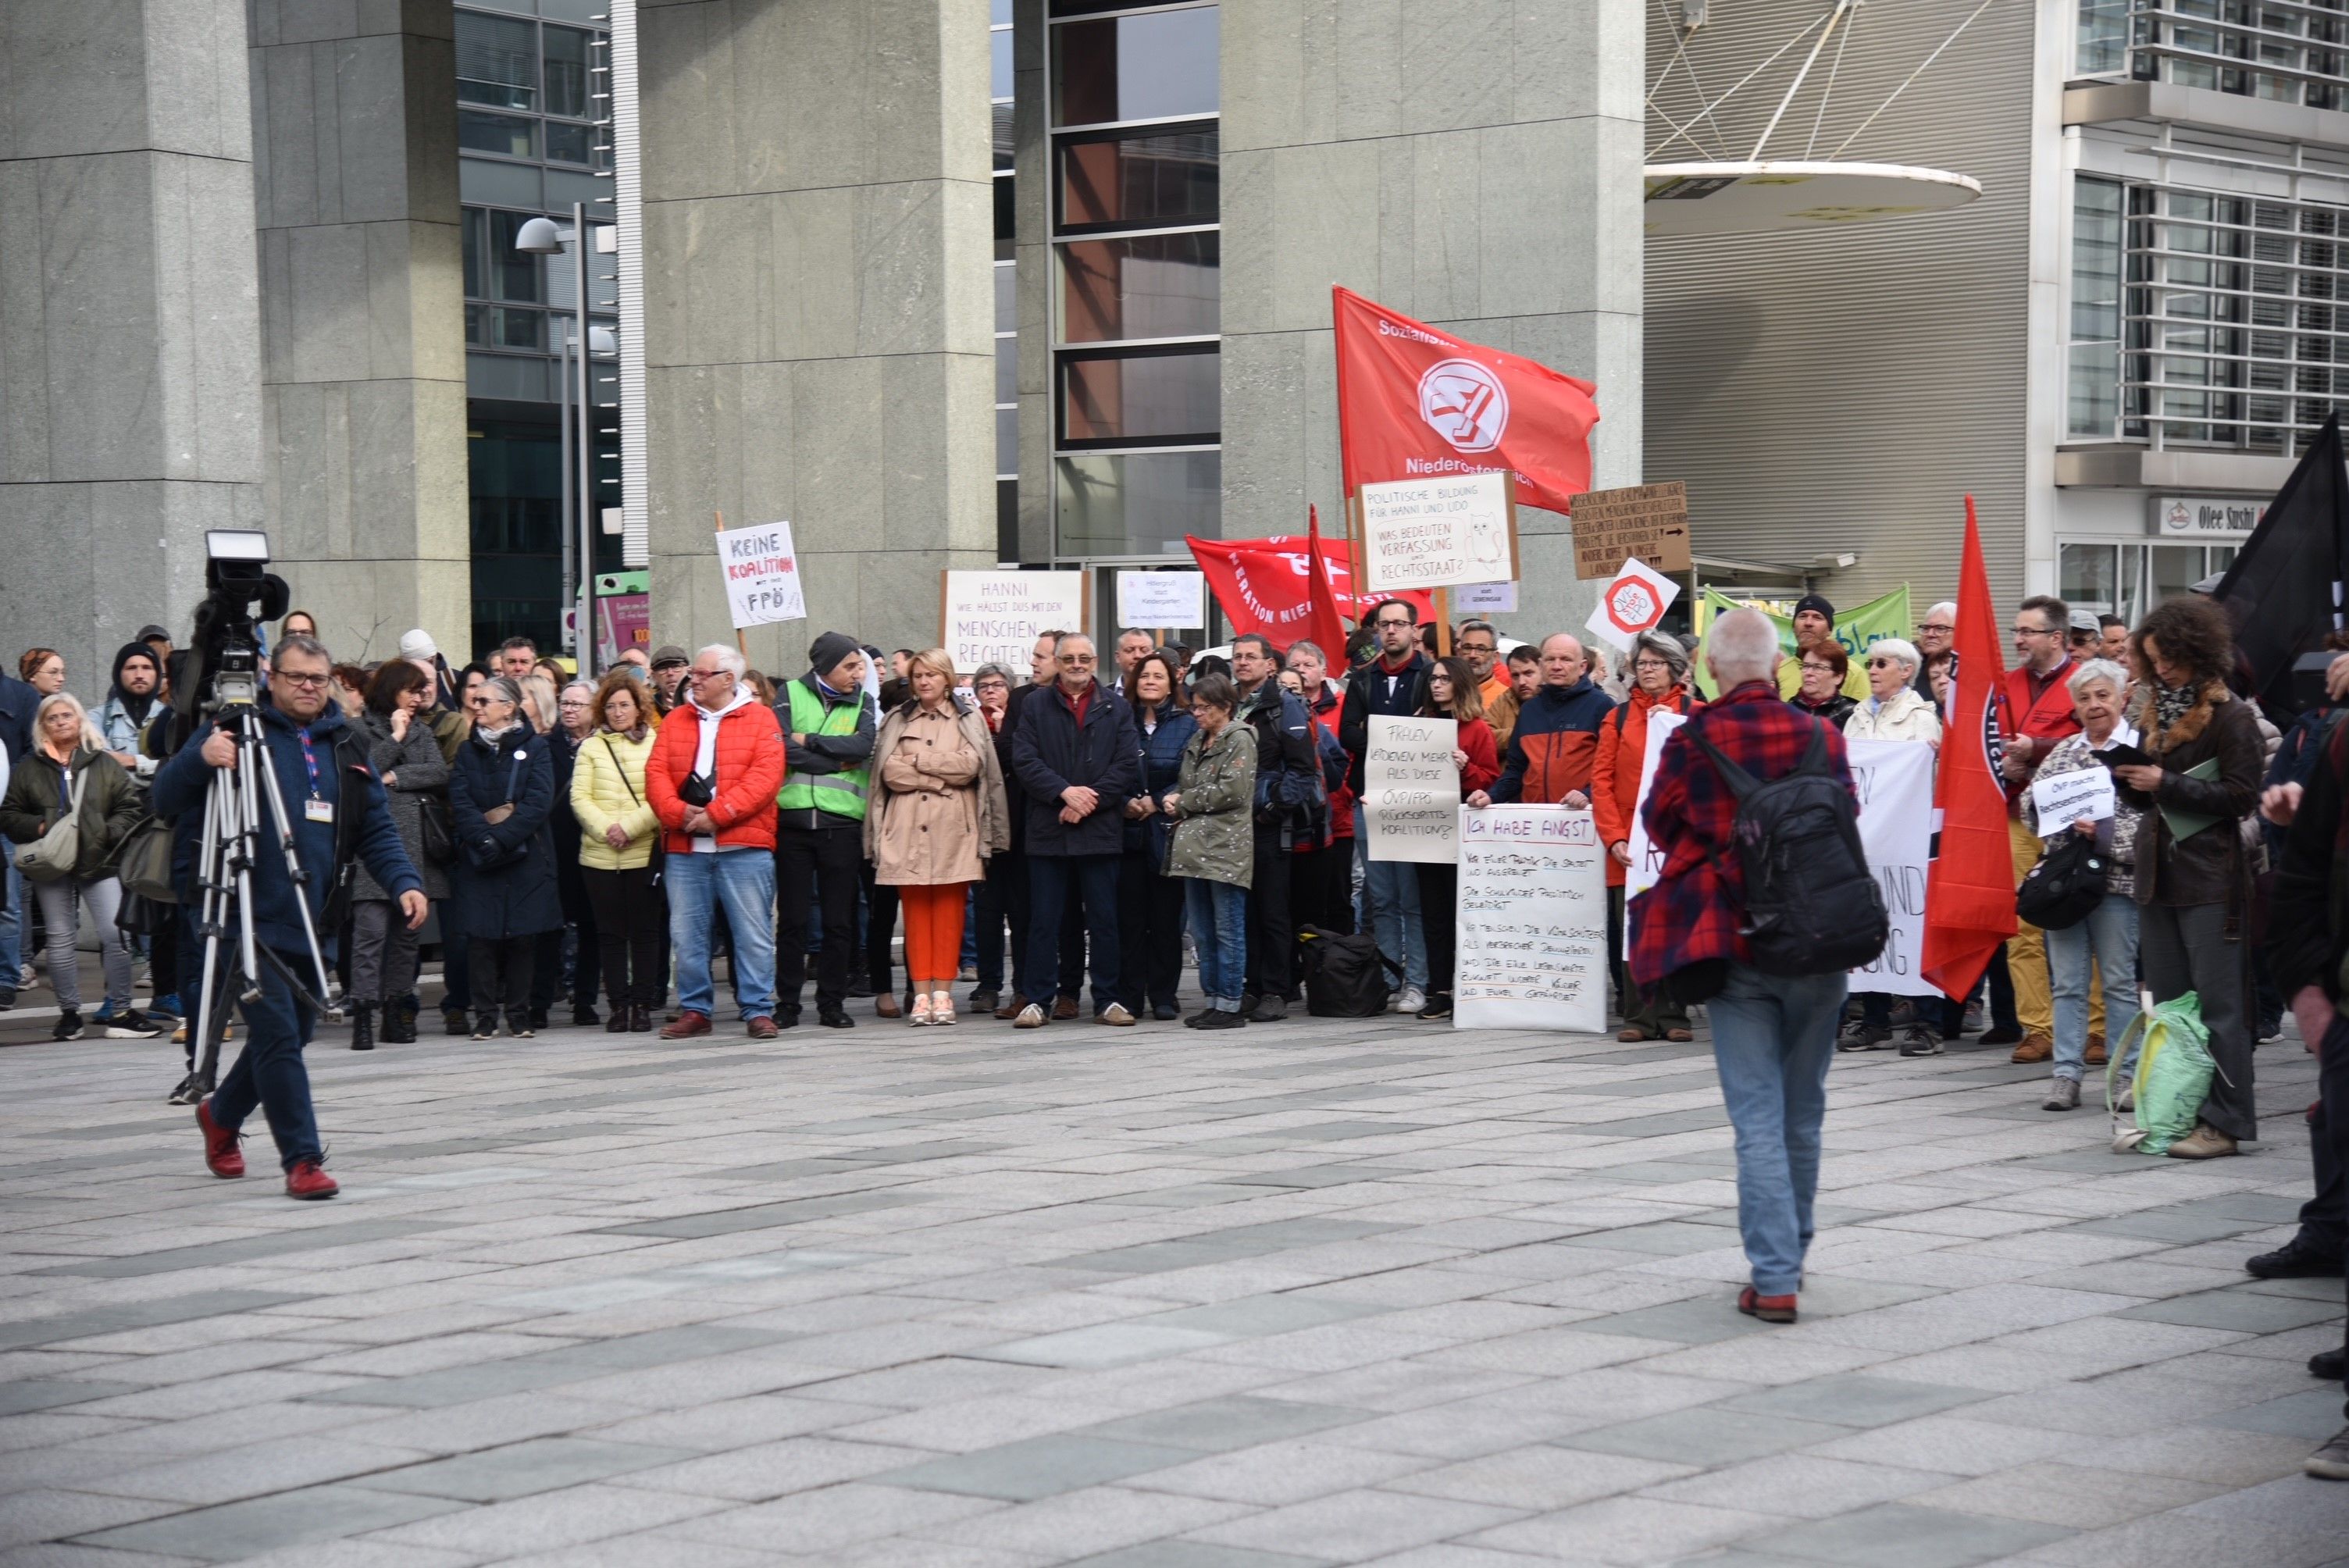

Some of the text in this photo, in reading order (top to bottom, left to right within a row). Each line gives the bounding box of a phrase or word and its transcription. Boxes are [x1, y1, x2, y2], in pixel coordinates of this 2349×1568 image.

[1367, 485, 1478, 504] POLITISCHE BILDUNG
[1370, 500, 1468, 519] FÜR HANNI UND UDO
[2198, 505, 2223, 529] Olee
[2226, 506, 2255, 530] Sushi
[1377, 522, 1452, 541] WAS BEDEUTEN
[1379, 537, 1453, 557] VERFASSUNG
[1381, 558, 1464, 580] RECHTSSTAAT?
[982, 580, 1028, 597] HANNI
[747, 587, 784, 611] FPÖ
[1386, 725, 1434, 742] FRAUEN
[1421, 751, 1450, 763] MEHR
[1387, 767, 1442, 780] ALS DIESE
[1381, 823, 1453, 840] KOALITION?
[1493, 818, 1533, 836] HABE
[1542, 818, 1590, 839] ANGST
